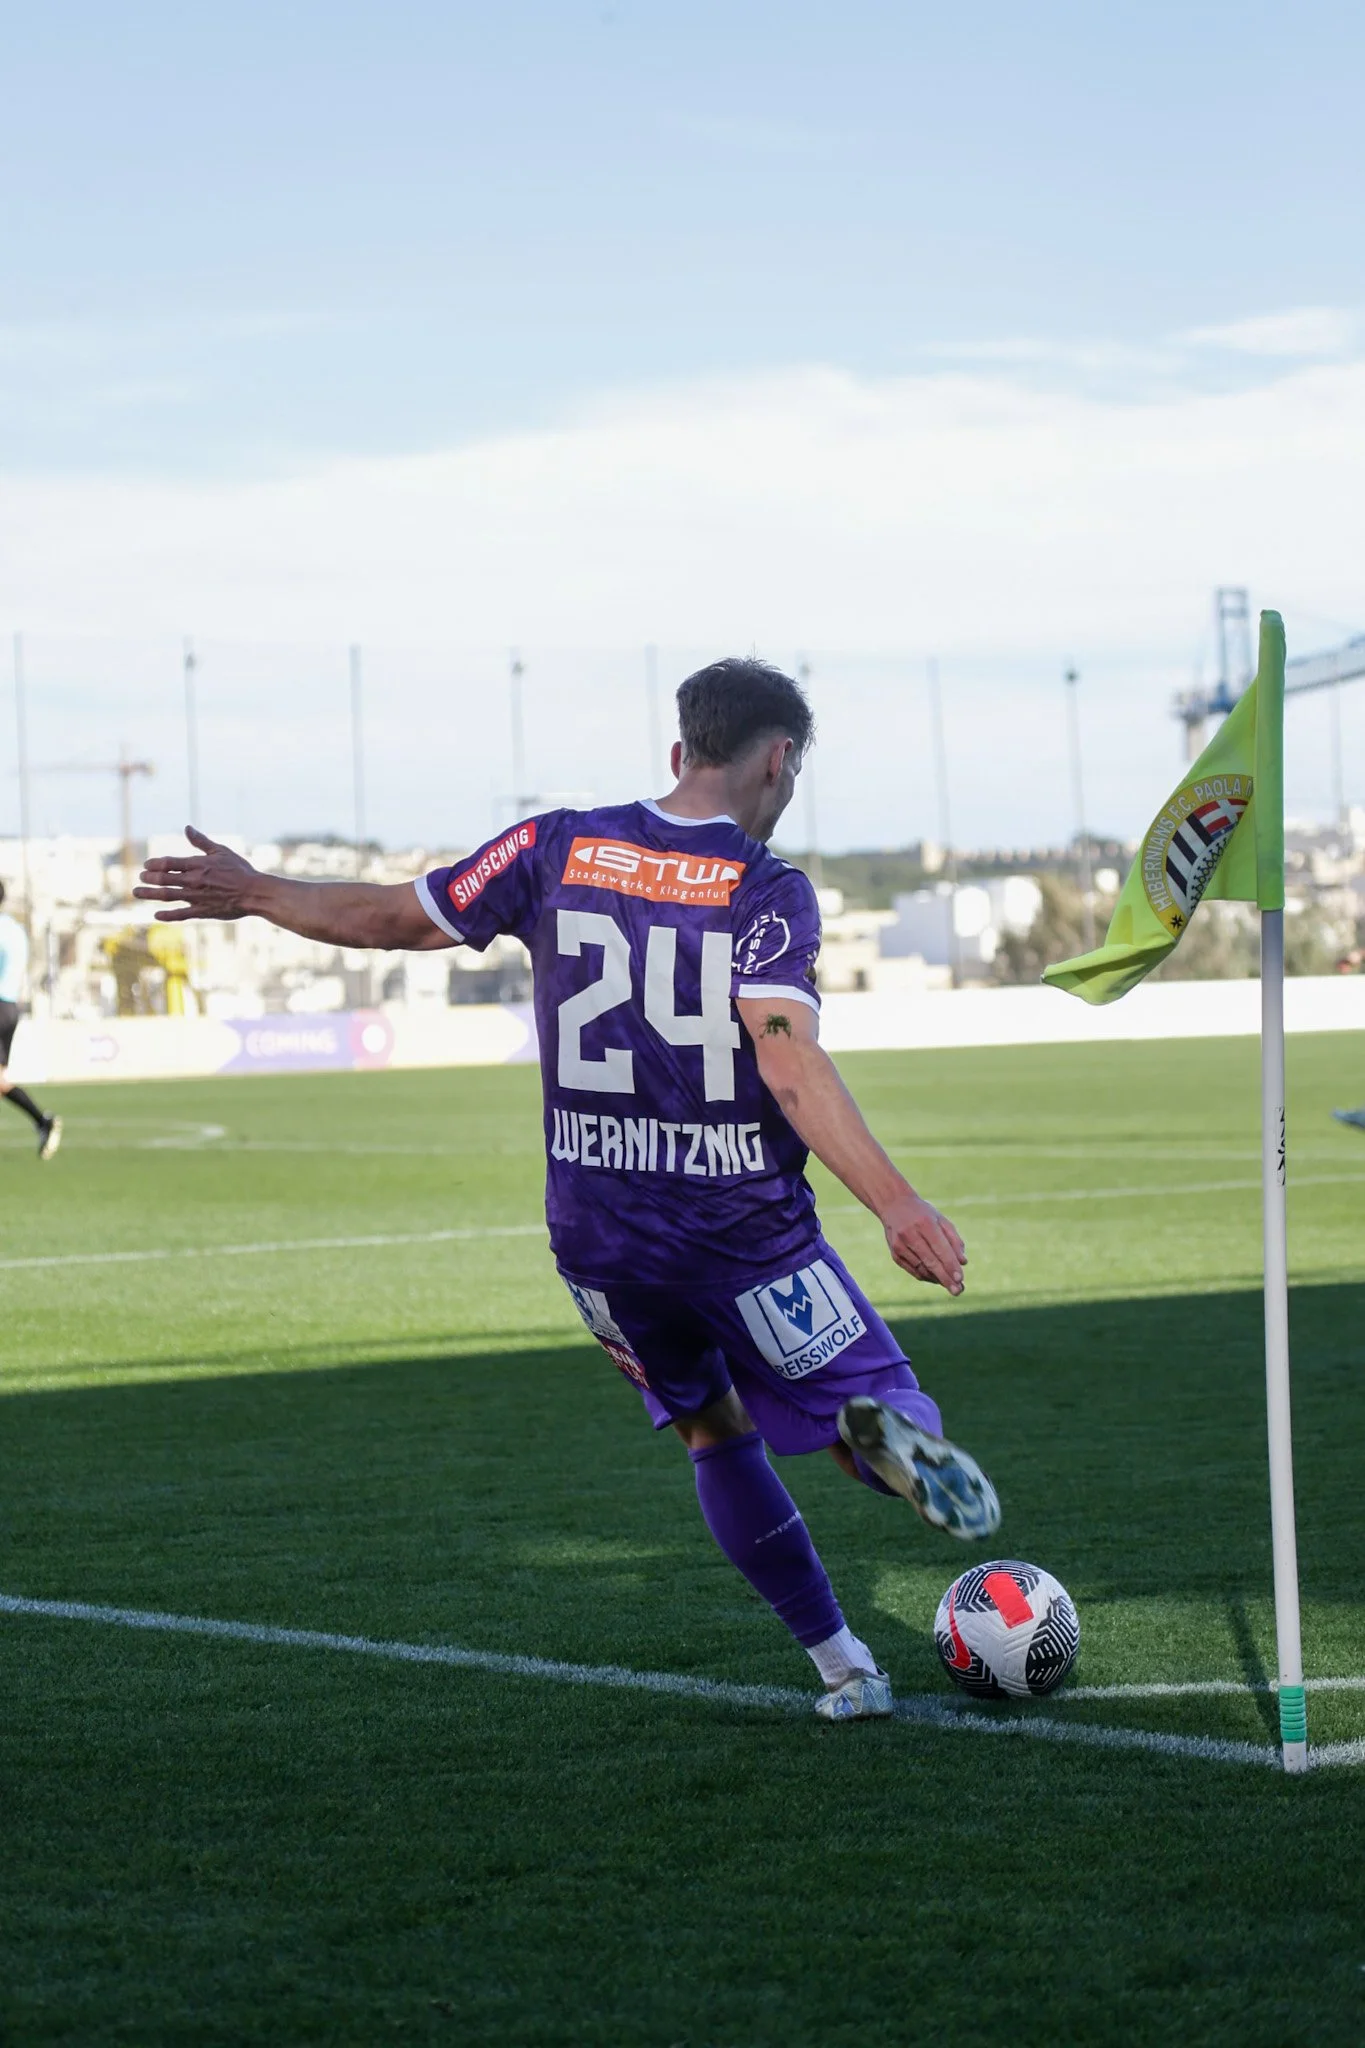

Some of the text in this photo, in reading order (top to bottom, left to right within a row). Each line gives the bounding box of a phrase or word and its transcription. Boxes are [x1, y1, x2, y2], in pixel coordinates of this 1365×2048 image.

[454, 828, 529, 904] SINTSCHNIG
[594, 846, 720, 885] STW
[1145, 816, 1176, 912] HIBERNIANS
[1194, 778, 1241, 801] PAOLA
[569, 869, 726, 900] Stadtwerke Klagenfur
[557, 909, 741, 1102] 24
[551, 1108, 765, 1176] WERNITZNIG
[774, 1315, 860, 1377] REISSWOLF
